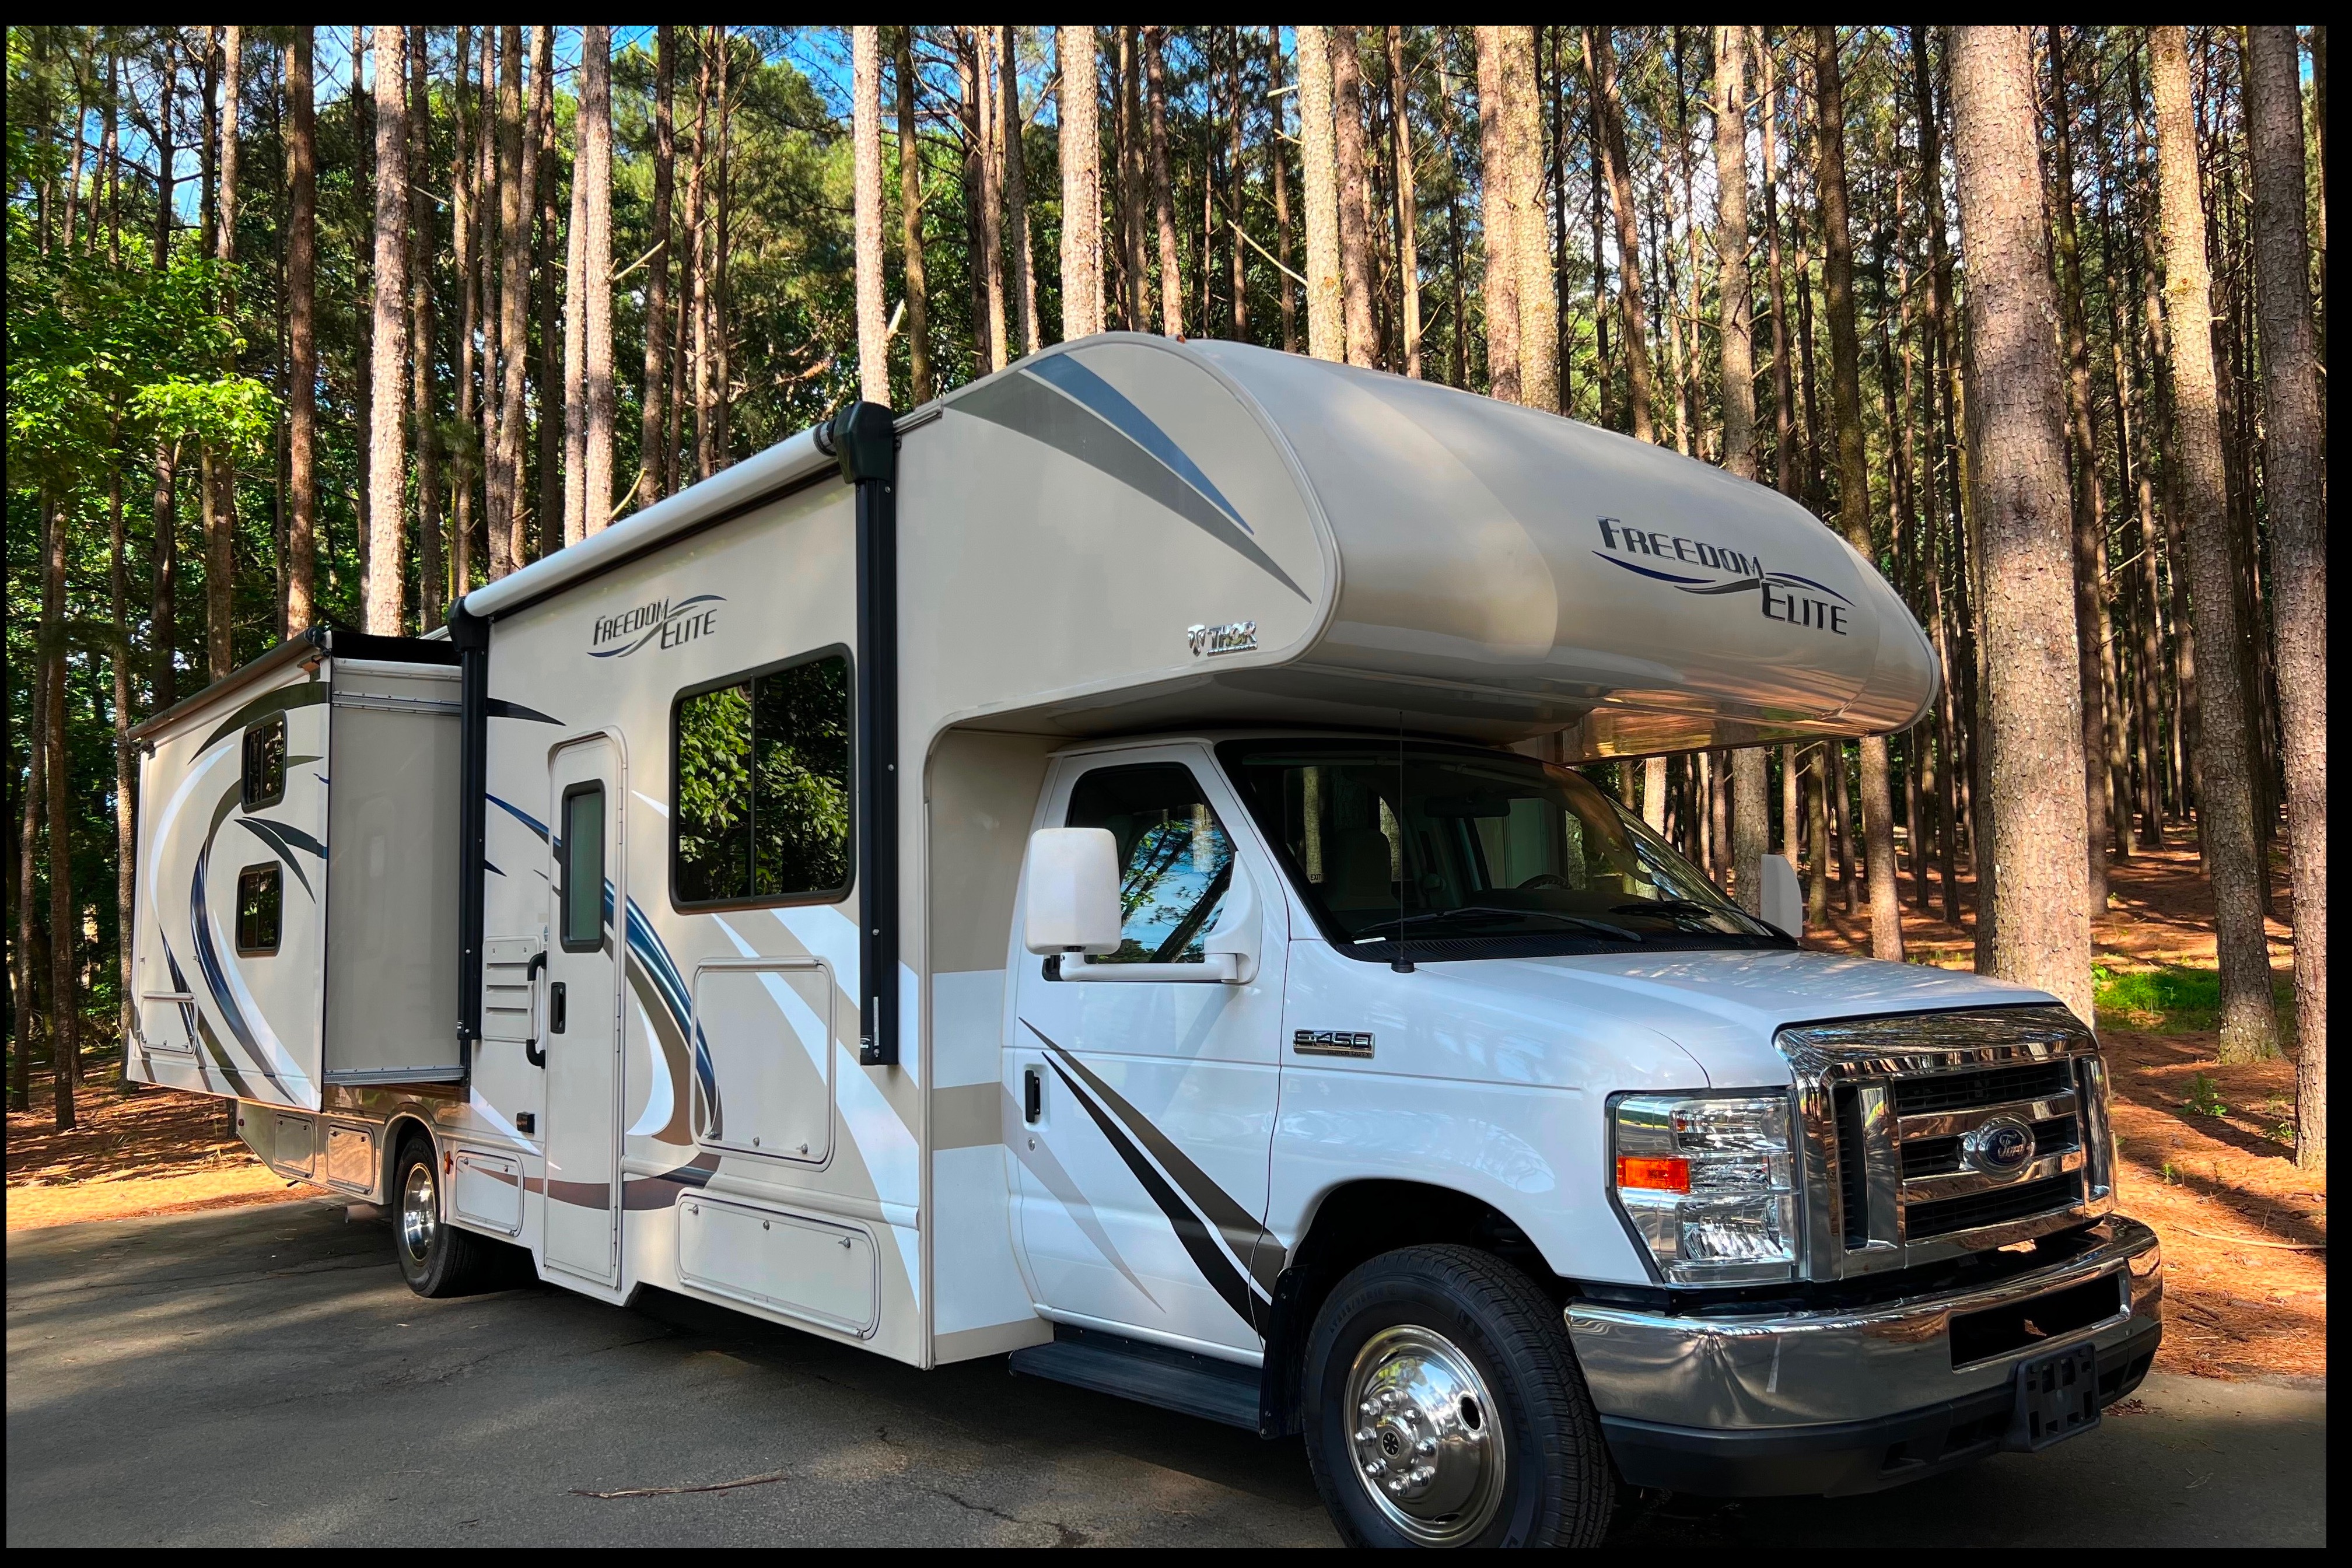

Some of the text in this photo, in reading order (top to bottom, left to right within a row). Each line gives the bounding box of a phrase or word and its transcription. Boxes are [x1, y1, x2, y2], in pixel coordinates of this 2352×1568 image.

[1596, 516, 1765, 580] FREEDOM
[593, 596, 670, 646] FREEDOM
[660, 608, 718, 650] ELITE
[1761, 580, 1848, 636] ELITE
[1207, 621, 1258, 649] THOR
[1997, 1133, 2025, 1159] Ford
